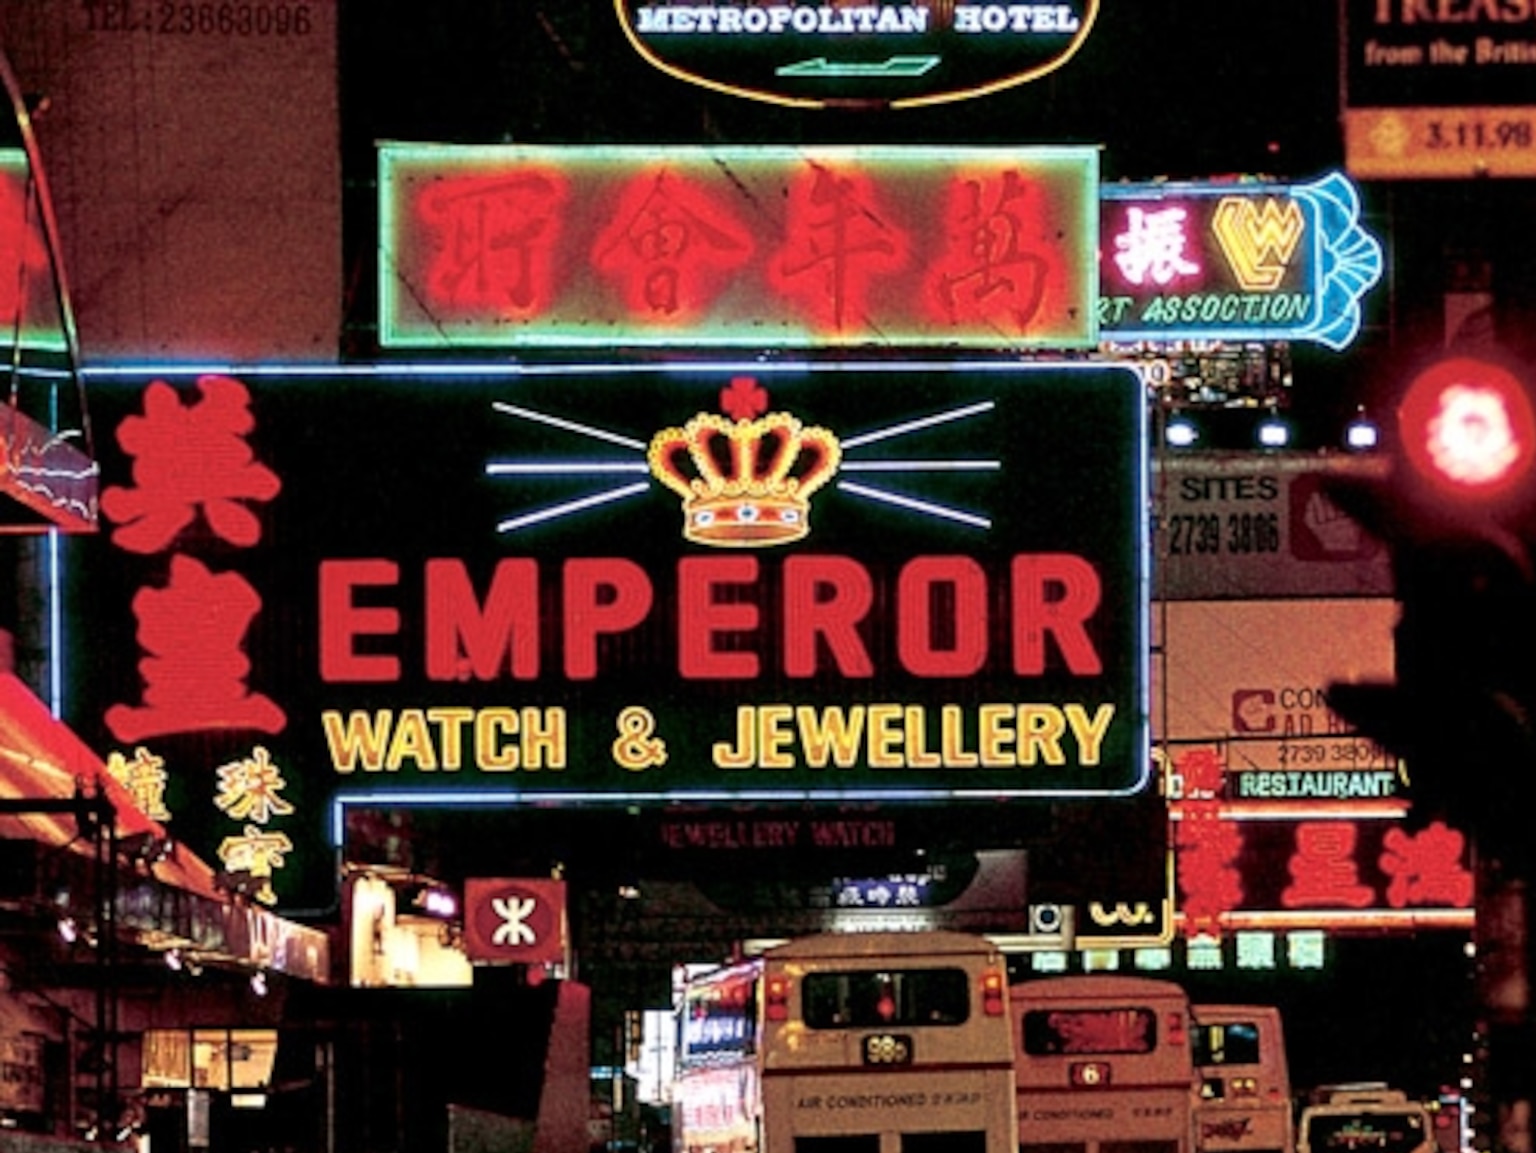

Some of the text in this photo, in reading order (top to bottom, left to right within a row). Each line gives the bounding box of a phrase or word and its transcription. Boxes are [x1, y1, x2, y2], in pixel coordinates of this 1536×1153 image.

[637, 4, 1078, 33] METROPOLITAN HOTEL
[1365, 41, 1422, 66] from
[1429, 41, 1468, 64] the
[1425, 119, 1533, 149] 3.11.98
[1142, 293, 1311, 323] ASSOCTION
[1180, 476, 1279, 501] SITES
[1169, 513, 1220, 555] 2739
[318, 553, 1104, 682] EMPEROR
[322, 702, 1117, 772] WATCH & JEWELLERY
[1239, 771, 1396, 798] RESTAURANT
[1082, 1064, 1100, 1085] 6
